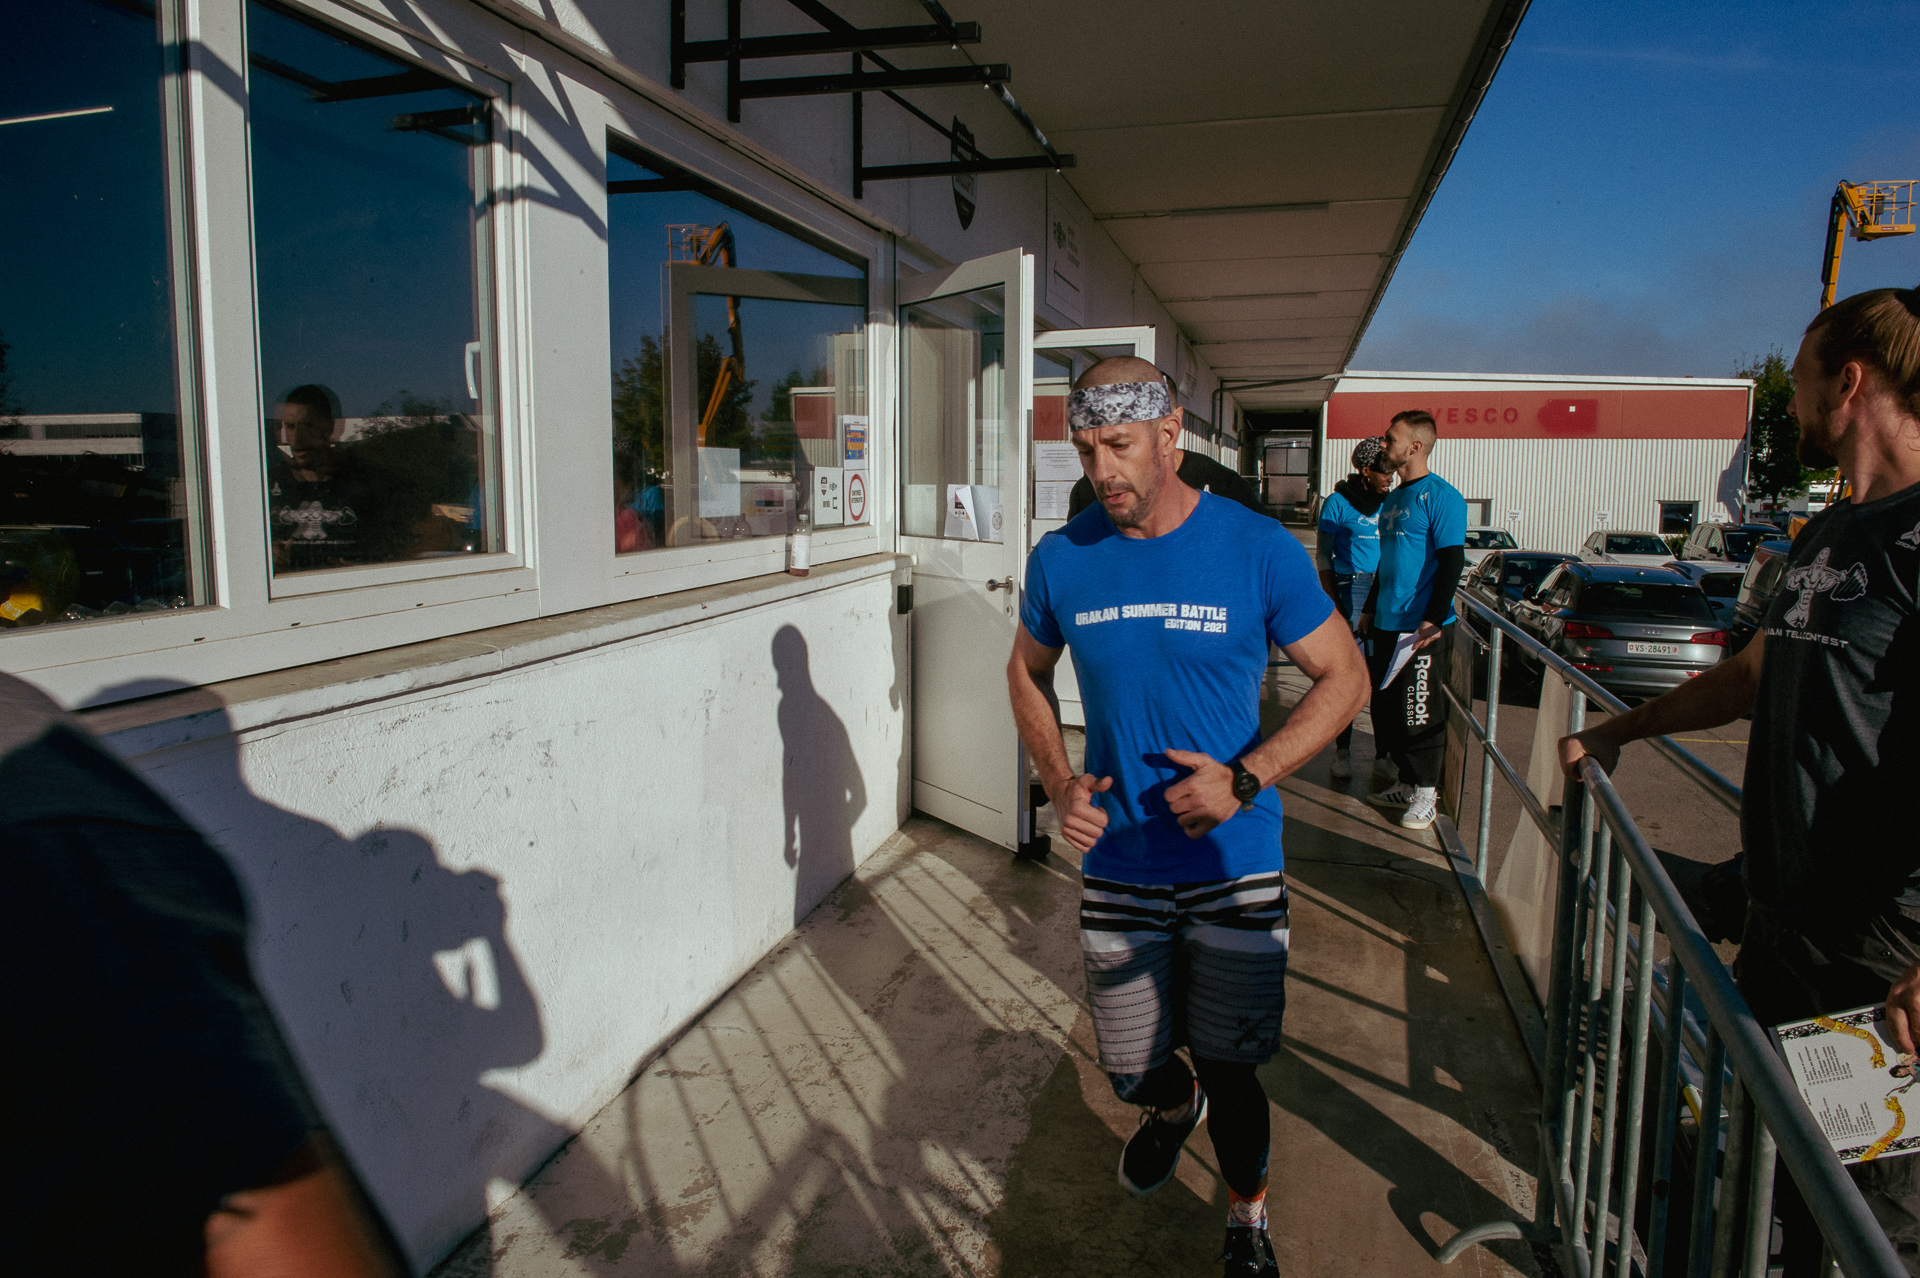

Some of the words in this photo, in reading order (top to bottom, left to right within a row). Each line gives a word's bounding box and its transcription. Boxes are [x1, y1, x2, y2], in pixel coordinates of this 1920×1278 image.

[1412, 407, 1519, 424] VESCO
[1075, 606, 1119, 626] URAKAN
[1121, 603, 1178, 618] SUMMER
[1180, 603, 1227, 621] BATTLE
[1164, 618, 1201, 631] EDITION
[1203, 621, 1227, 633] 2021
[1414, 654, 1432, 726] Reebok
[1406, 685, 1415, 727] CLASSIC
